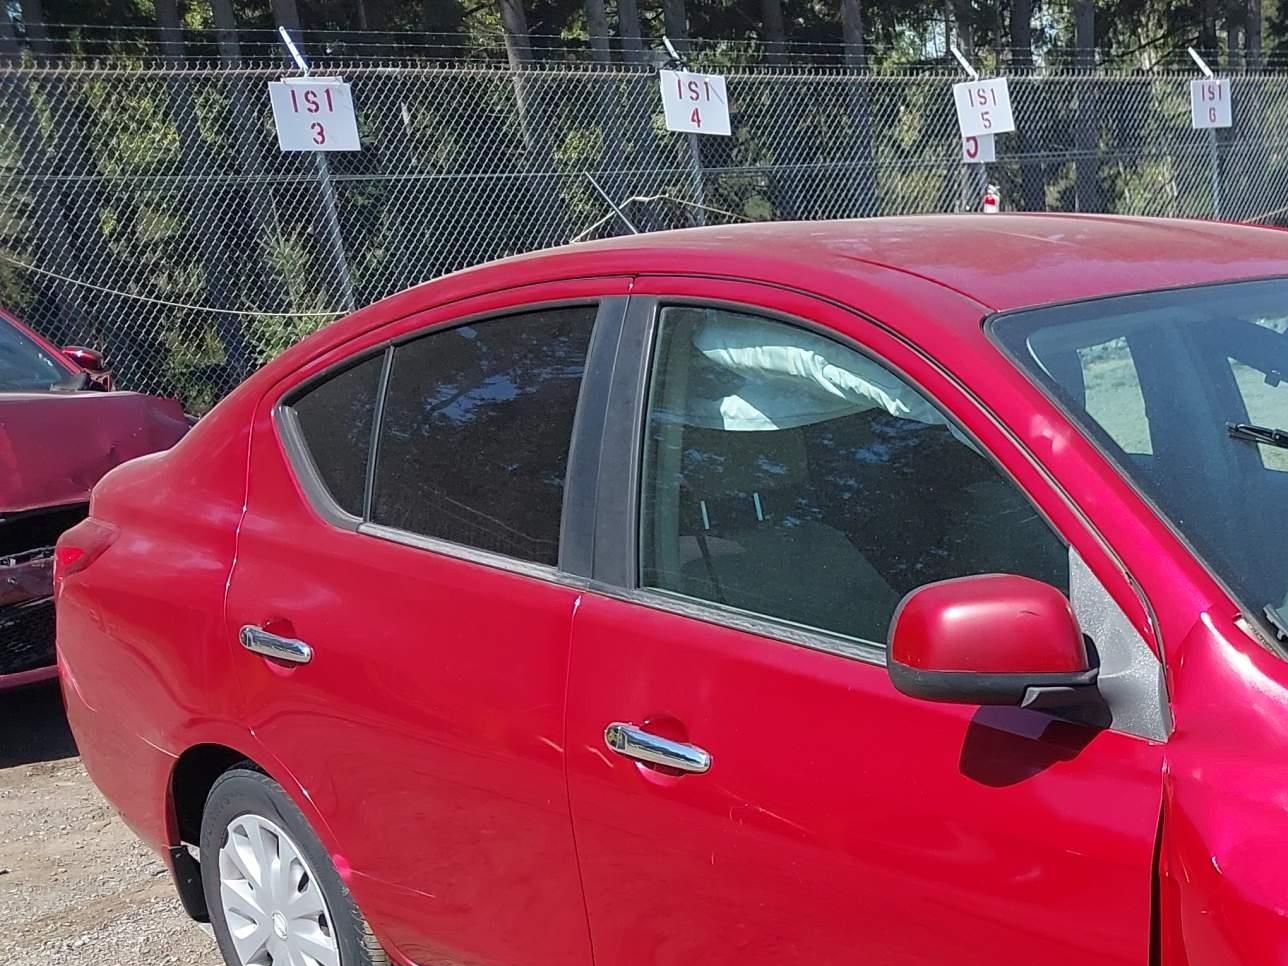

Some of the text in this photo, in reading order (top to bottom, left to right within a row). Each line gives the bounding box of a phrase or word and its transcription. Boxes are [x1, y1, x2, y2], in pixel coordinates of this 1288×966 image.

[691, 108, 701, 128] 4
[981, 111, 992, 129] 5
[311, 123, 325, 144] 3
